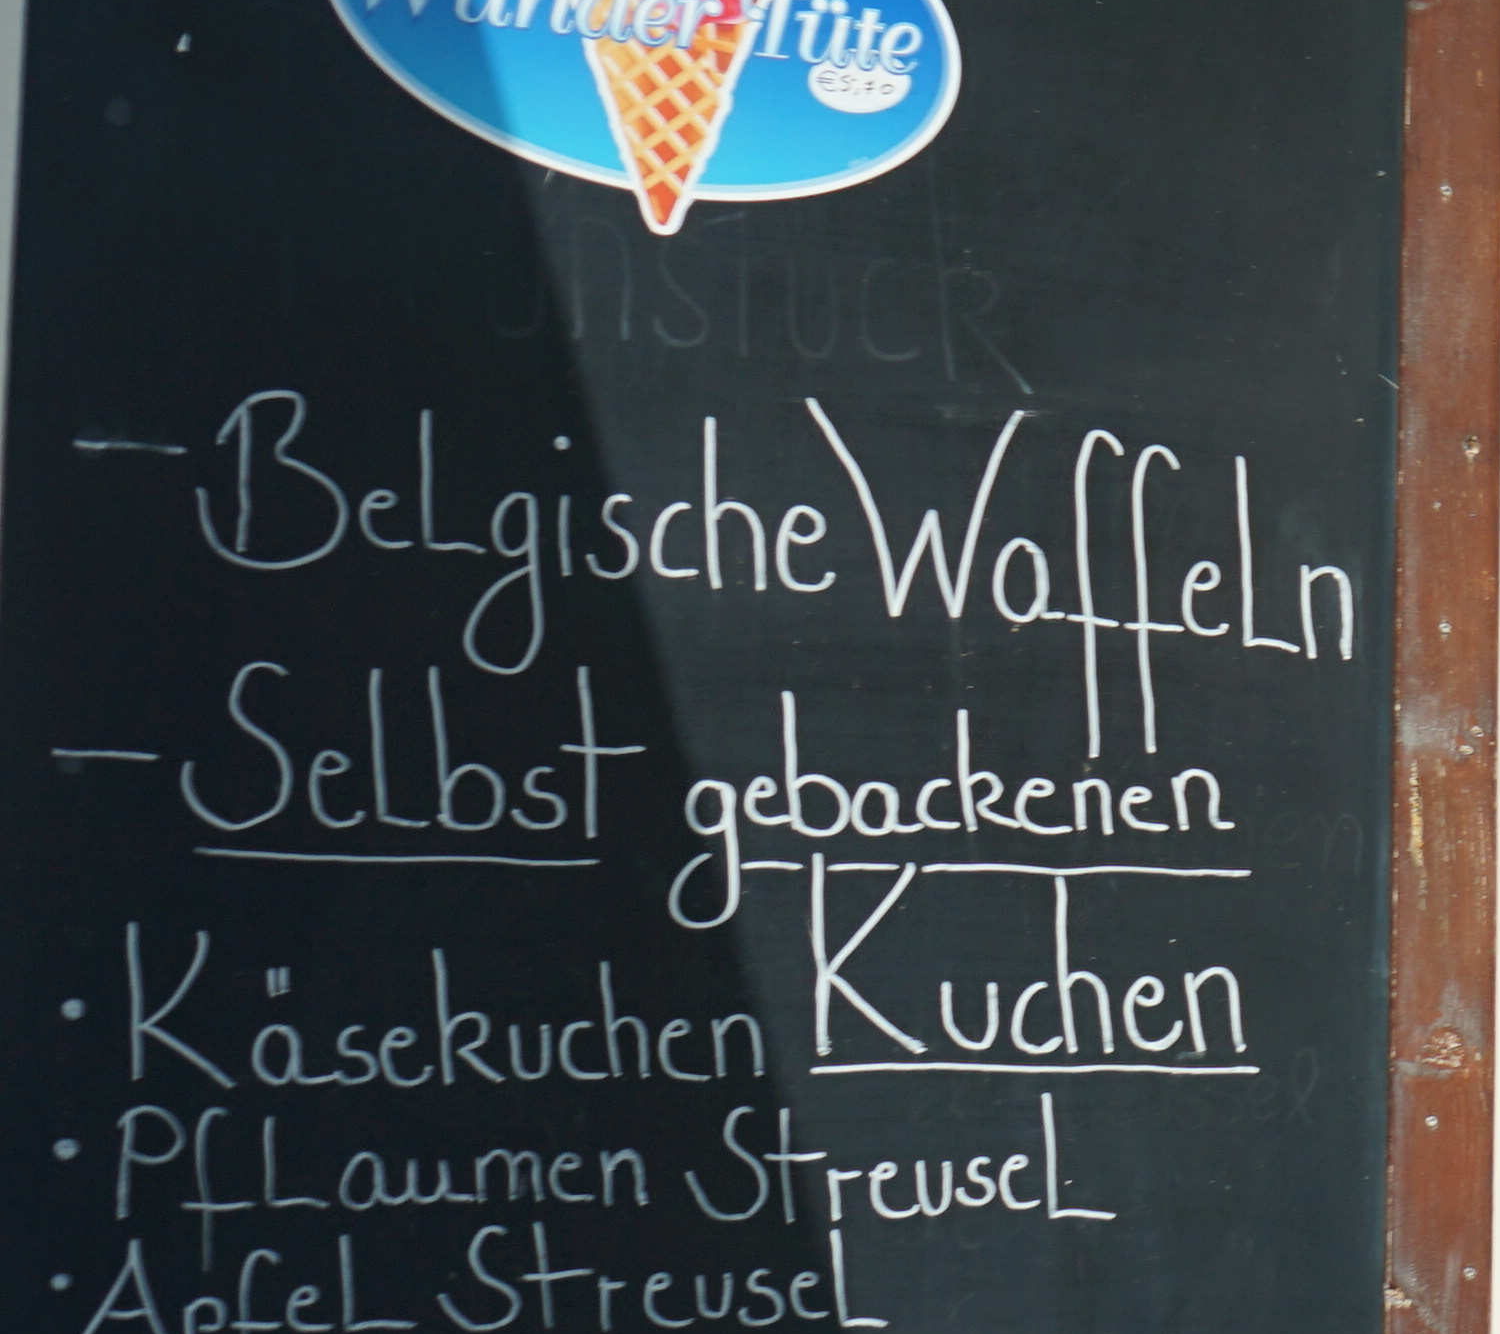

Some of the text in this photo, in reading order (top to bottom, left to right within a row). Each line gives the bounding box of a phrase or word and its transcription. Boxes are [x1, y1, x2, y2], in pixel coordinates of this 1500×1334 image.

[198, 389, 1354, 757] Belgische Waffeln
[181, 663, 1235, 927] Selbst gebackenen
[127, 921, 765, 1091] Käsekuchen
[812, 854, 1247, 1057] Kuchen
[685, 1095, 1117, 1221] Streusel
